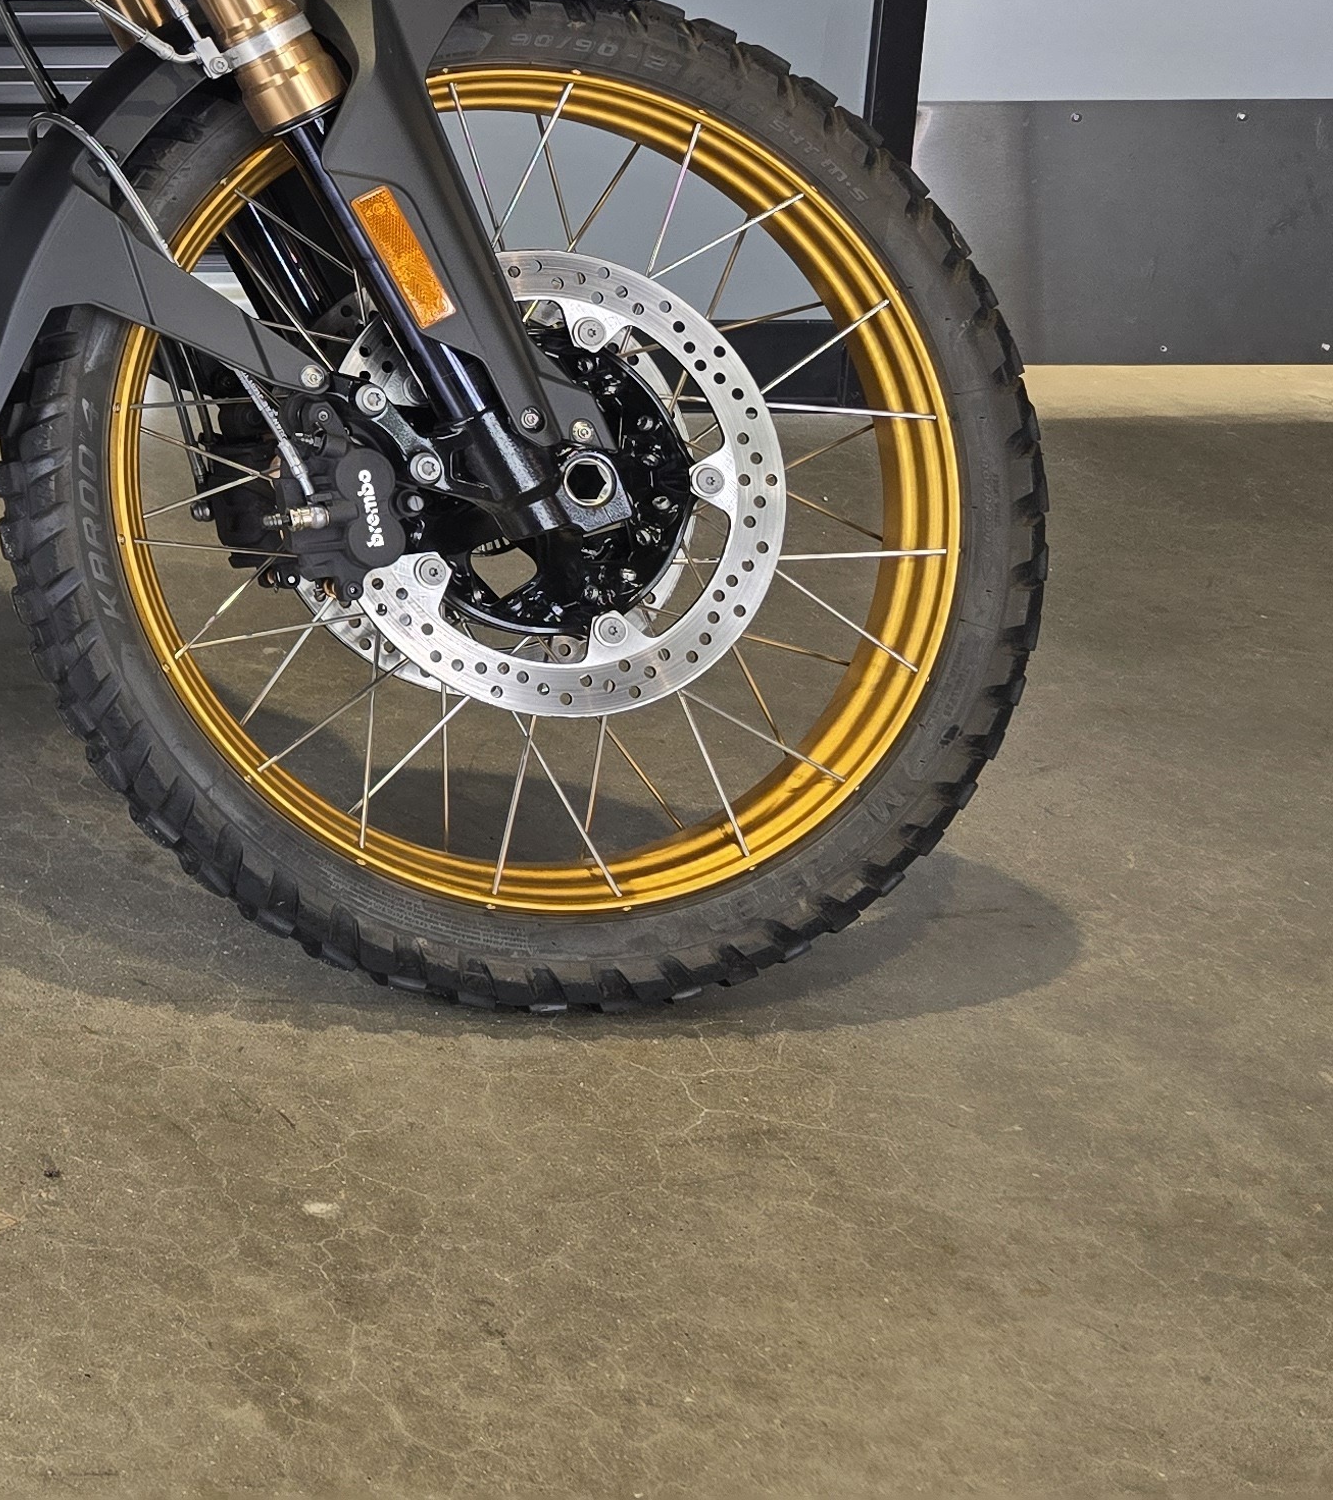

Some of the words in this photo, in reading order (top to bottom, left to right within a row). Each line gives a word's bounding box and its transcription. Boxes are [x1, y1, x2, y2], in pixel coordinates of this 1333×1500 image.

[509, 33, 621, 58] 90/90
[77, 443, 127, 625] KAROO
[357, 469, 385, 548] brembo
